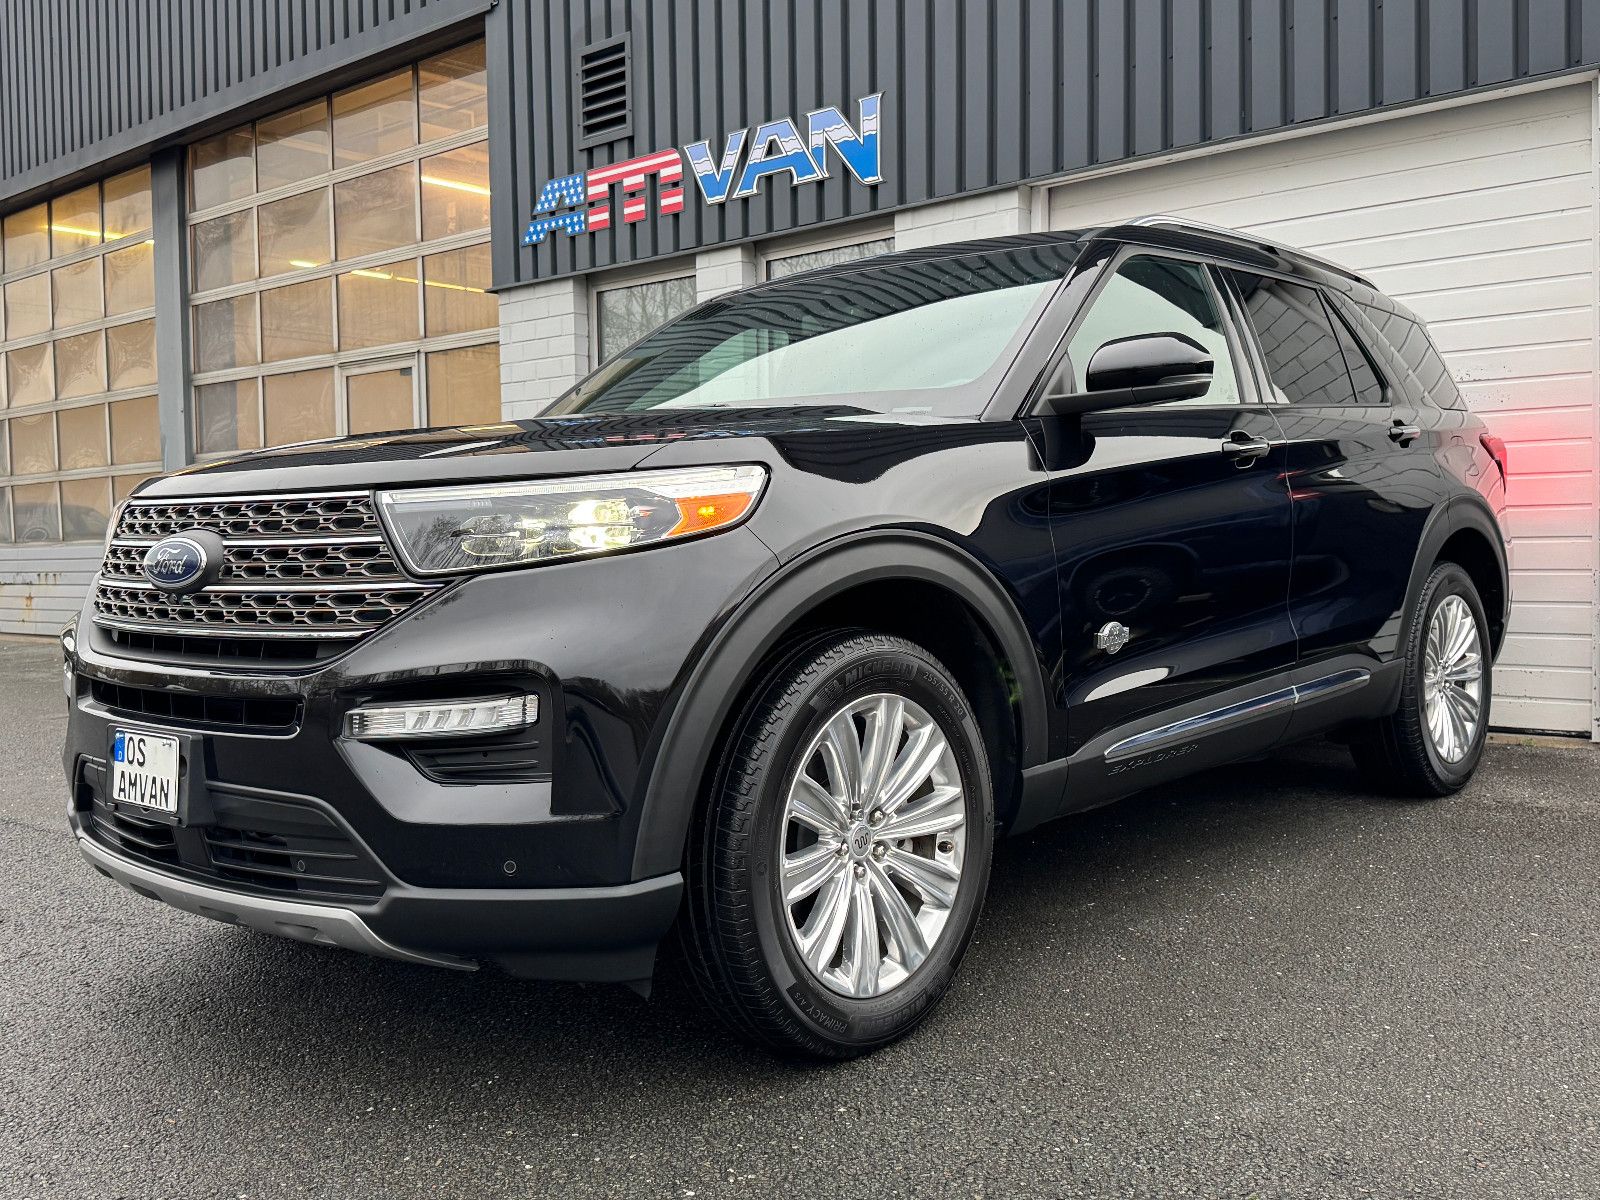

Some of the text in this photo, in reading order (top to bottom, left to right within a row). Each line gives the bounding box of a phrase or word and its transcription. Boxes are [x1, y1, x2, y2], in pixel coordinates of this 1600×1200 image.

[152, 547, 188, 574] Ford
[127, 736, 146, 767] OS
[118, 770, 170, 809] AMVAN
[806, 1006, 848, 1034] PRIMACY
